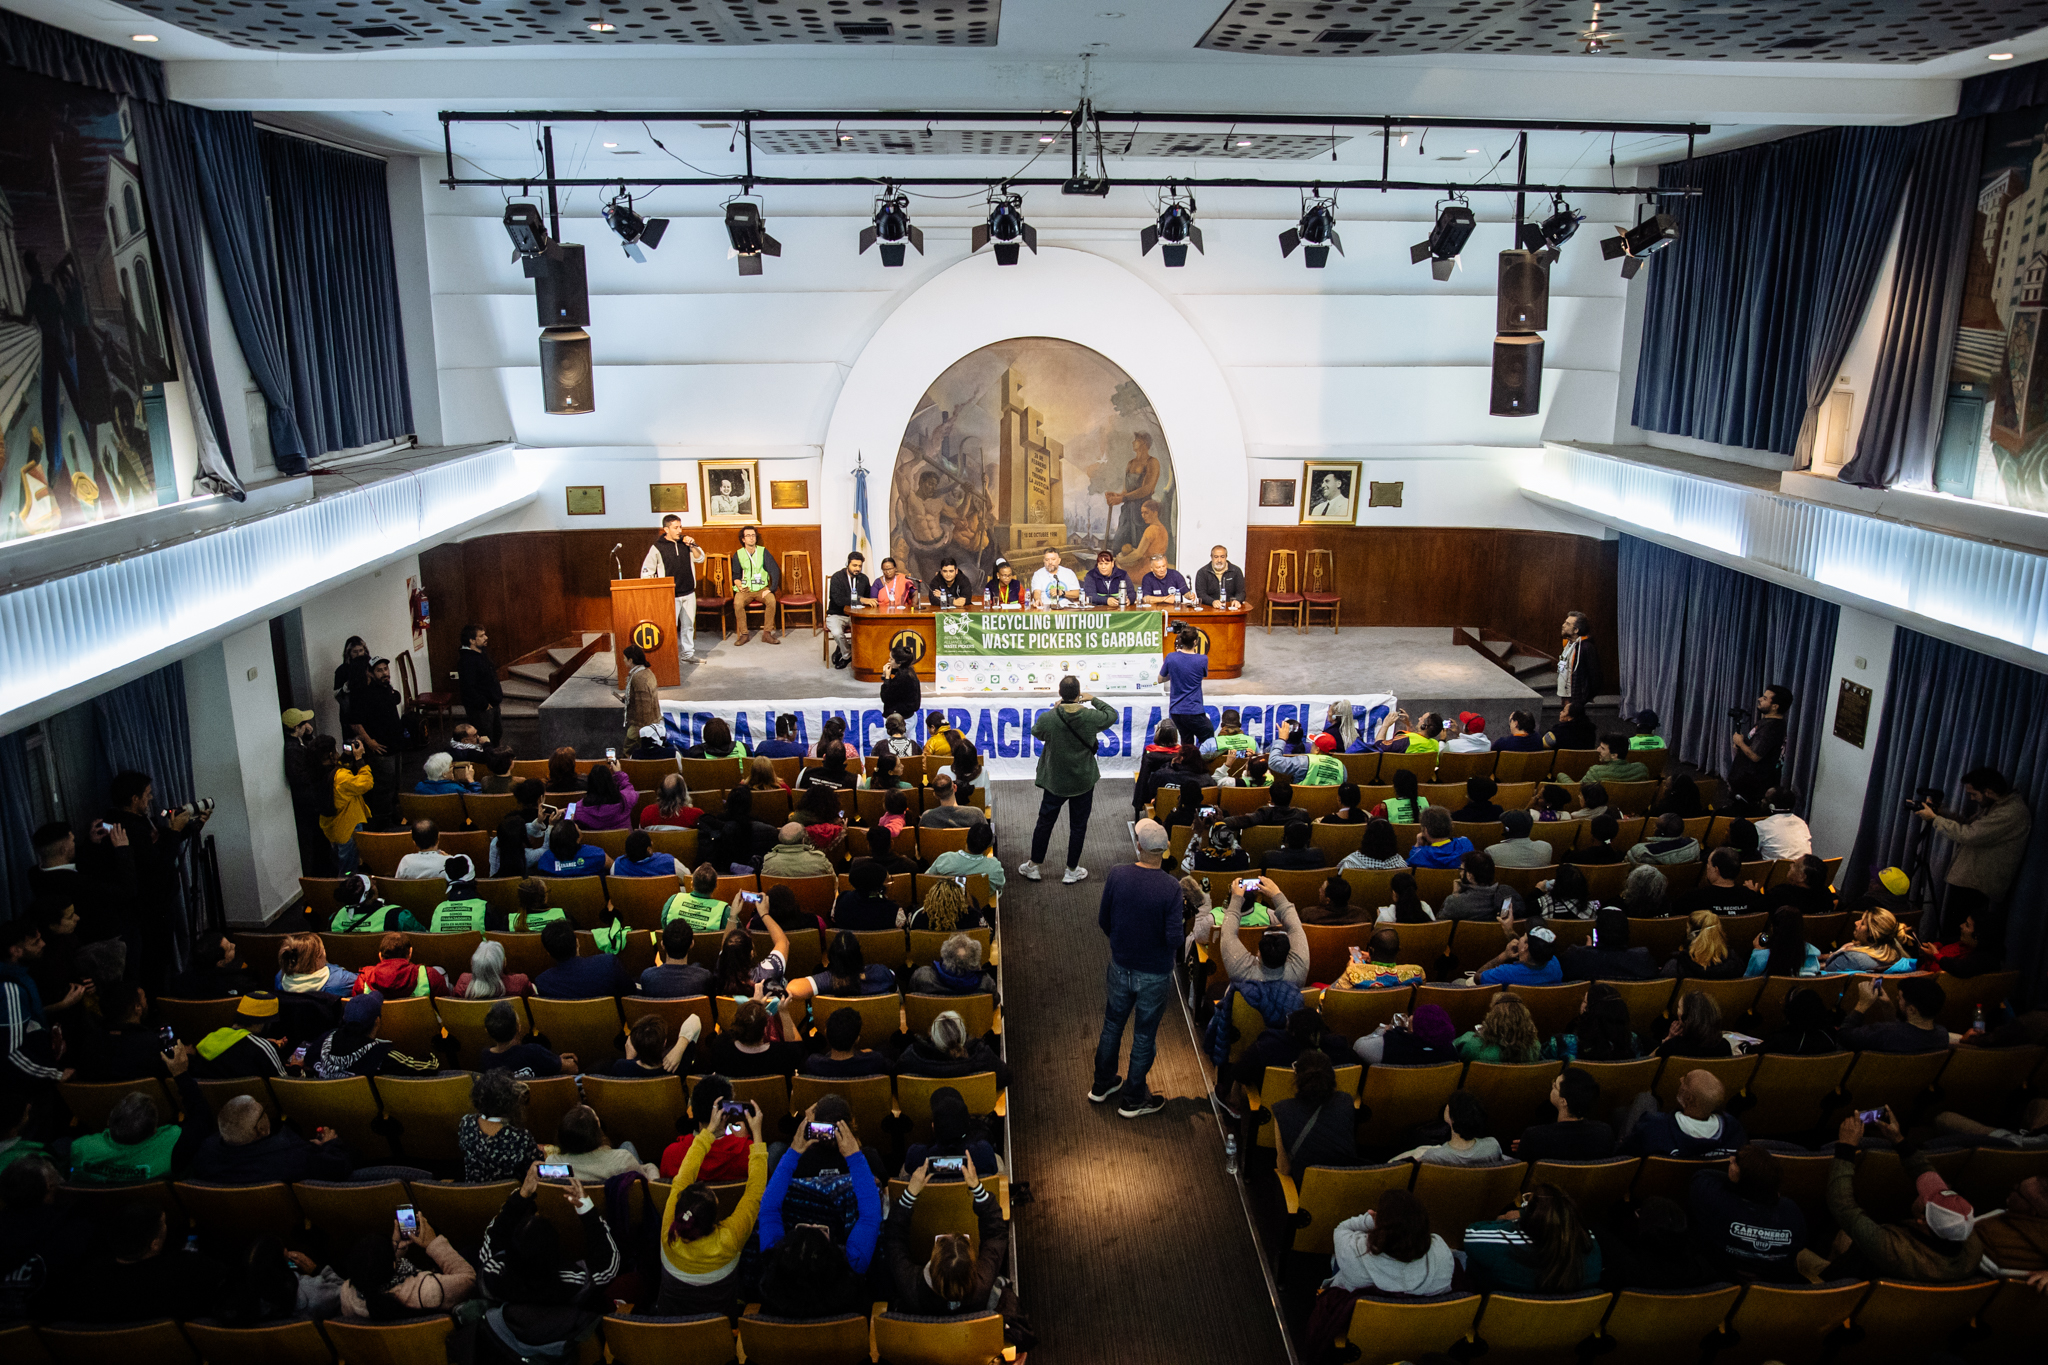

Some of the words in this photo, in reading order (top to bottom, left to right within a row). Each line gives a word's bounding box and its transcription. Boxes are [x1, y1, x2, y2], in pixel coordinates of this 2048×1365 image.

[982, 614, 1051, 631] RECYCLING
[1055, 613, 1112, 630] WITHOUT
[982, 633, 1025, 650] WASTE
[1029, 632, 1082, 649] PICKERS
[1086, 632, 1097, 648] IS
[1101, 631, 1159, 648] GARBAGE
[1733, 1225, 1789, 1239] CARTONEROS
